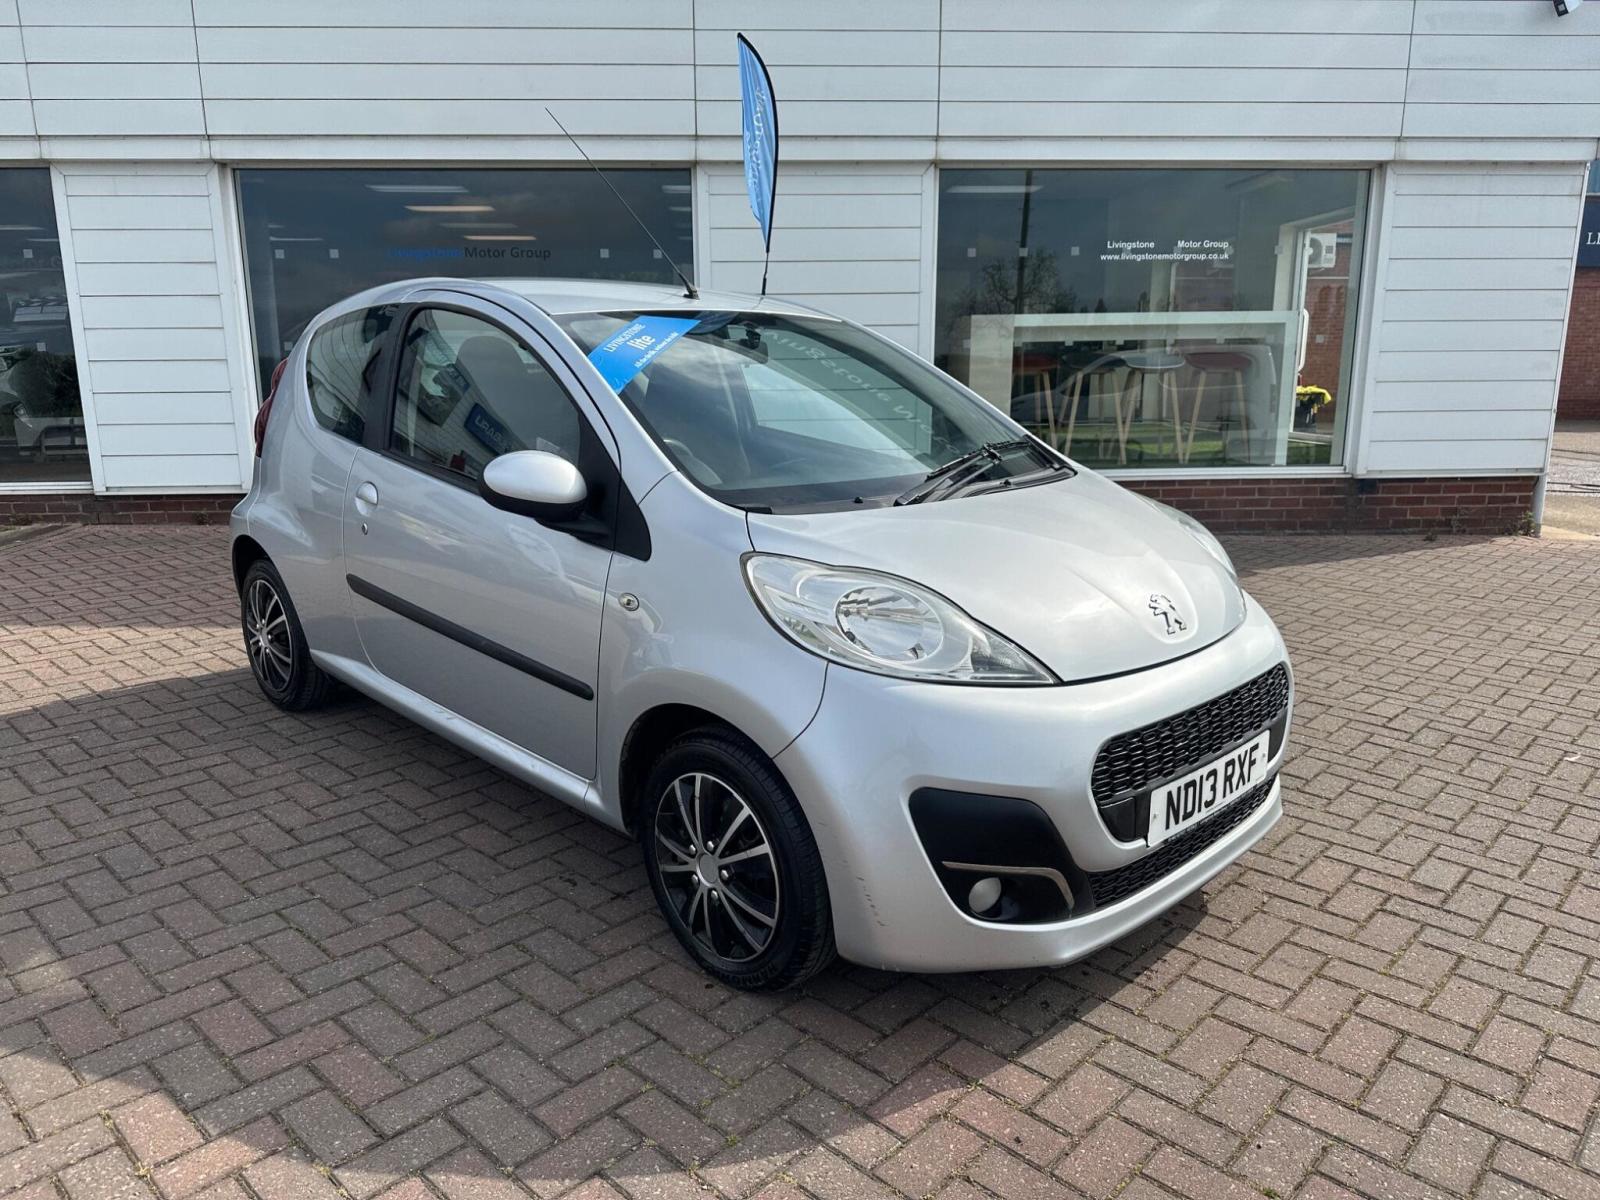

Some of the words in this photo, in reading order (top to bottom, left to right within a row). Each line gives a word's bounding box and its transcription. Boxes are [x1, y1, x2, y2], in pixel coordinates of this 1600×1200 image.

[1107, 241, 1155, 250] Livingstone
[1177, 240, 1202, 248] Motor
[1203, 240, 1229, 249] Group
[464, 247, 506, 258] Motor
[510, 247, 552, 261] Group
[1100, 252, 1229, 262] www.livingstonemotorgroup.co.uk
[604, 323, 645, 352] LIVINGSTONE
[626, 335, 656, 350] lite
[1165, 768, 1218, 831] ND13
[1222, 742, 1260, 799] RXF
